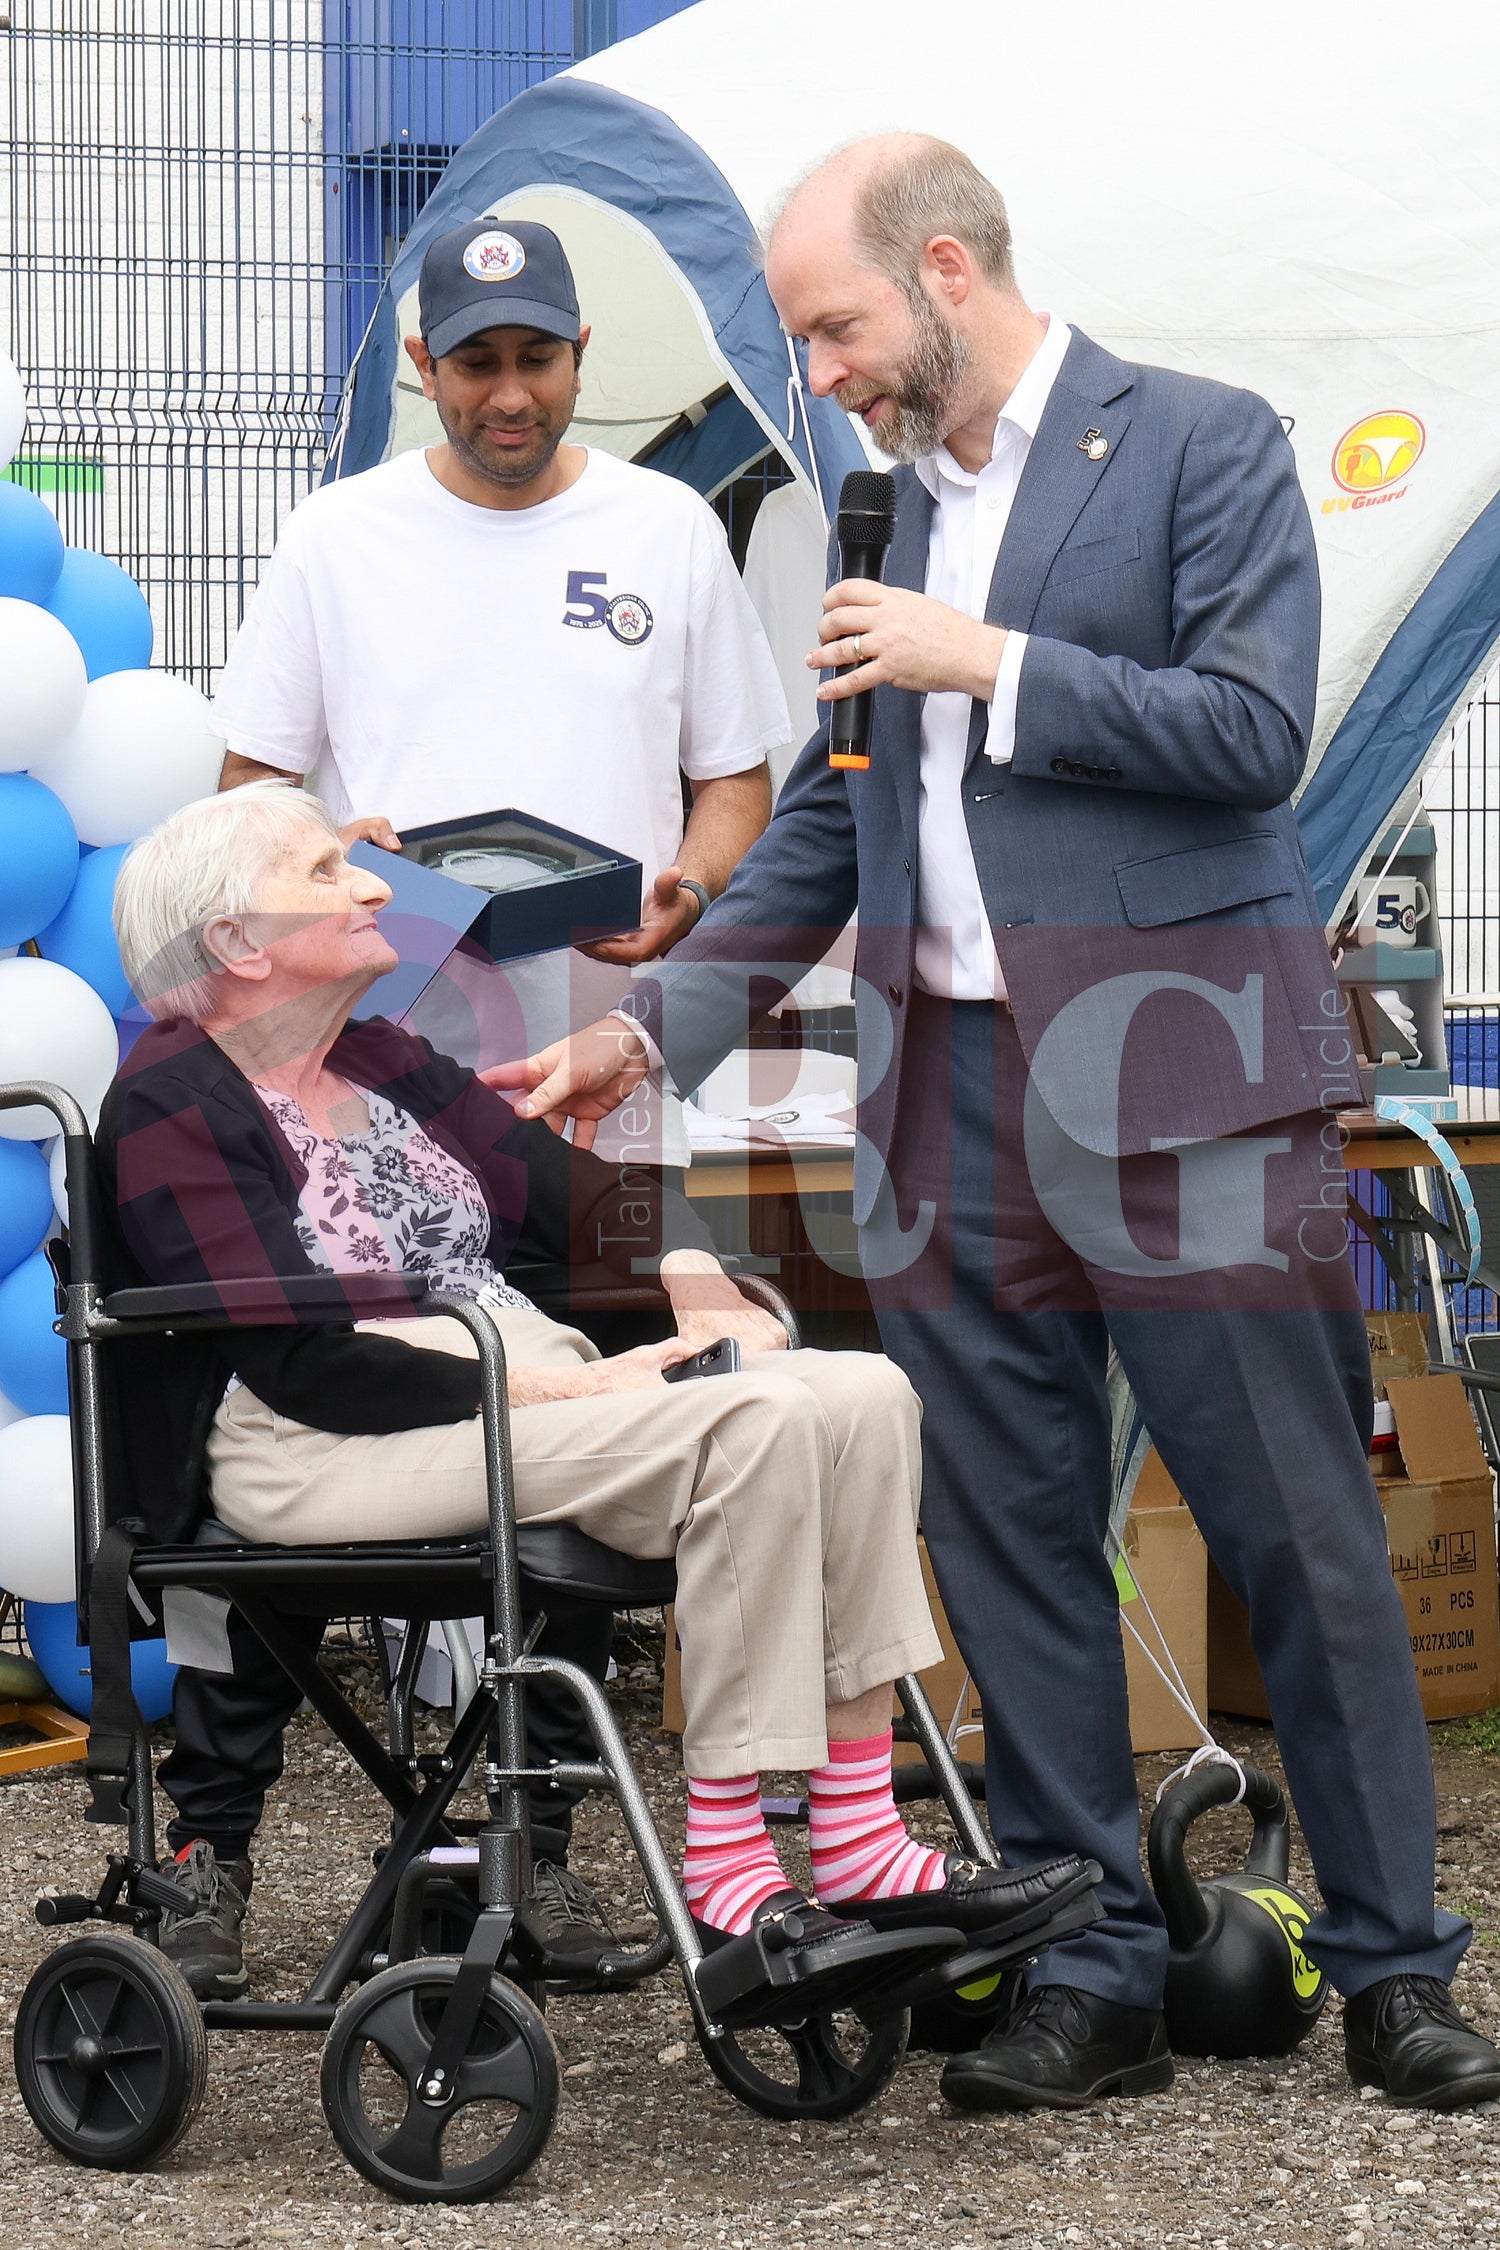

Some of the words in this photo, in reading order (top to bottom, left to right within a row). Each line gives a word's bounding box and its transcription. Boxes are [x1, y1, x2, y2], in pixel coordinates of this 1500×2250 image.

[1420, 1597, 1431, 1614] 36
[1450, 1590, 1474, 1611] PCS
[1423, 1665, 1444, 1677] MADE
[1447, 1664, 1454, 1673] IN
[1456, 1662, 1478, 1673] CHINA
